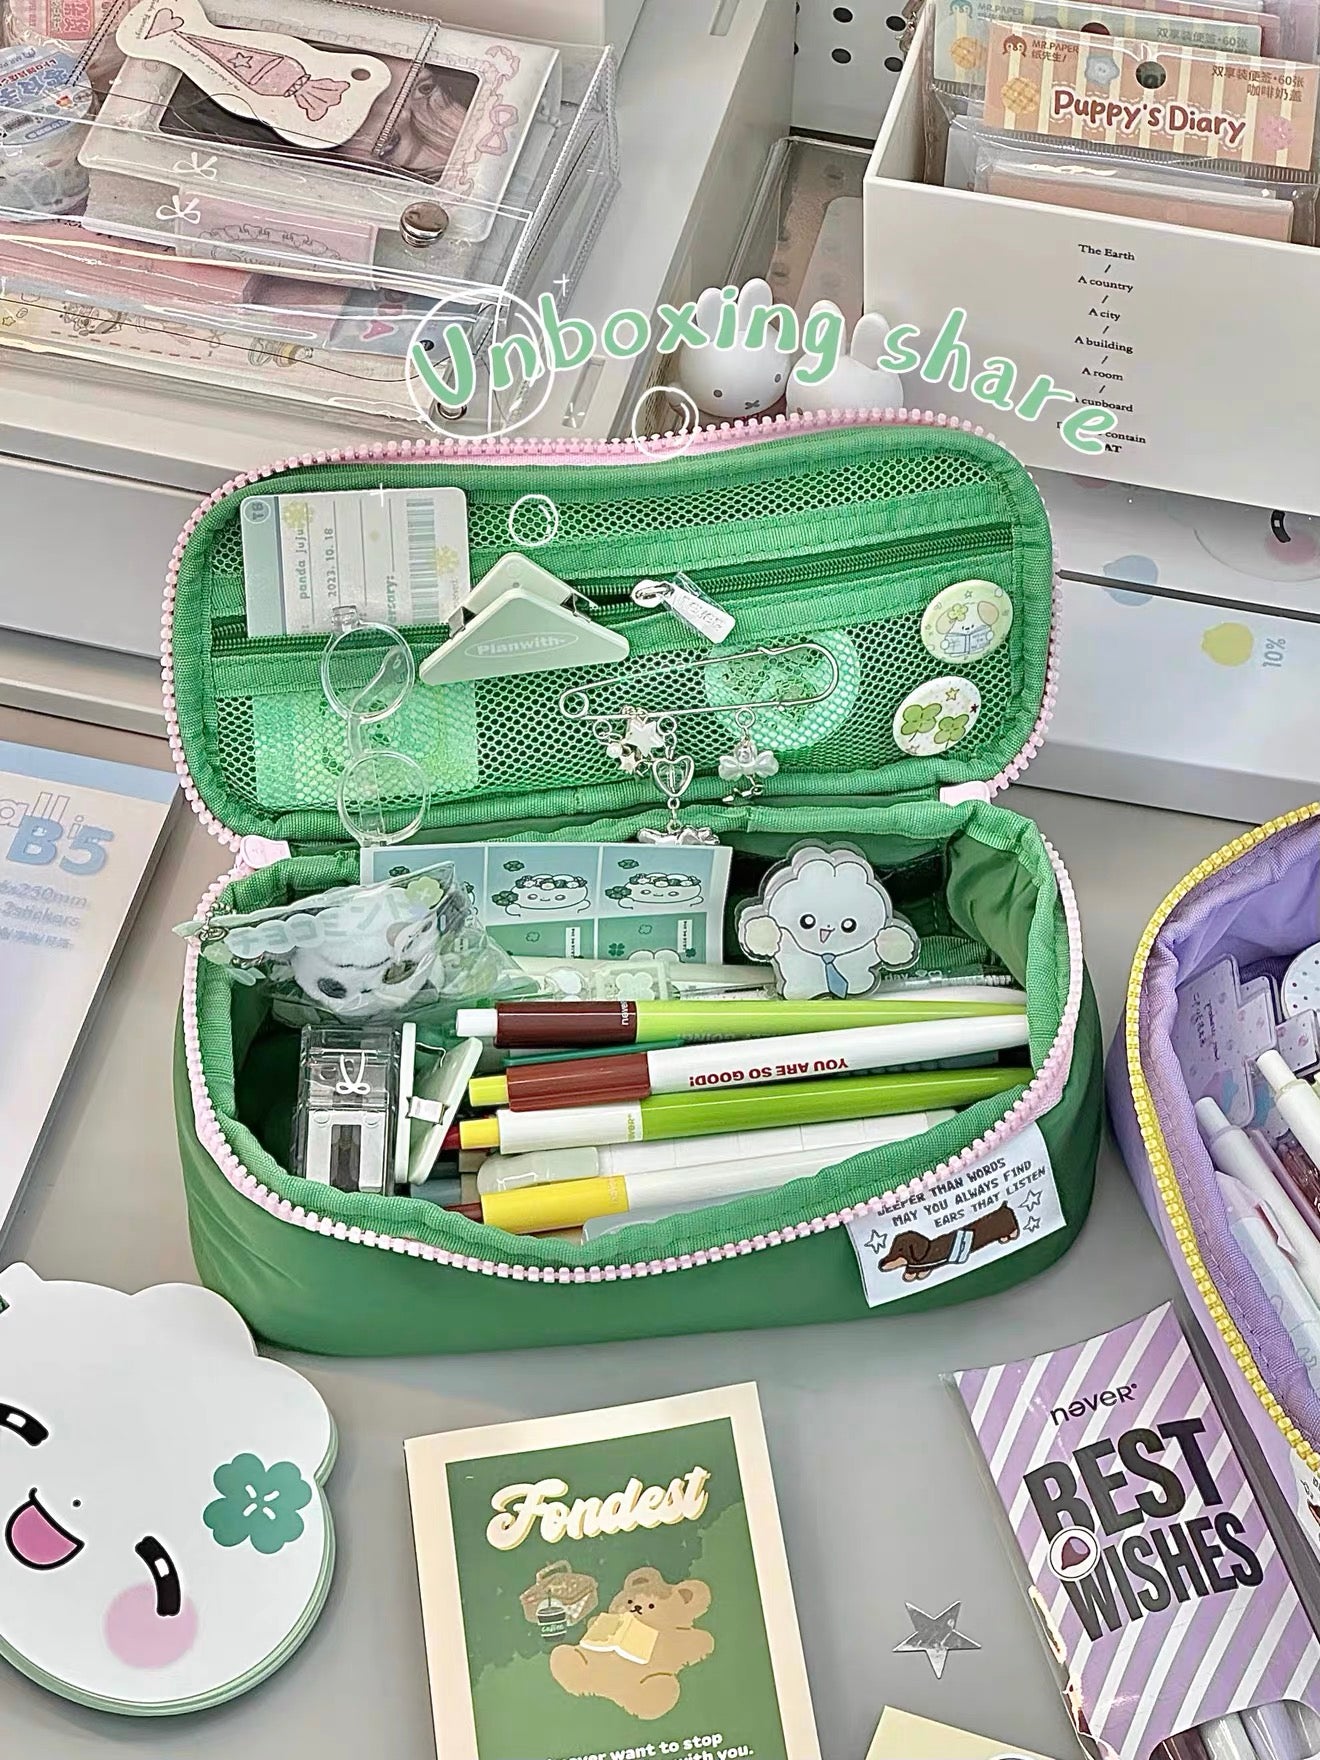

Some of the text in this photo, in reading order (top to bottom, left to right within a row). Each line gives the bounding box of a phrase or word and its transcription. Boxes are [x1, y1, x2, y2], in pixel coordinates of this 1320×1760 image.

[1054, 89, 1246, 144] Puppy's Diary
[1078, 244, 1135, 261] The Earth
[1078, 275, 1134, 293] A country
[1088, 307, 1121, 322] A city
[1074, 335, 1134, 355] A building
[1081, 367, 1124, 381] A room
[1104, 443, 1122, 454] AT
[1105, 430, 1147, 444] contain
[295, 560, 310, 600] panda
[386, 574, 399, 624] ersary:
[1262, 637, 1286, 669] 10%
[6, 814, 115, 876] B5
[689, 1057, 849, 1087] YOU ARE SO GOOD!
[892, 1160, 1032, 1227] MAY YOU ALWAYS FIND
[931, 1177, 964, 1198] THAN
[966, 1158, 1007, 1183] WORDS
[933, 1166, 1046, 1228] EARS THAT LISTEN
[1023, 1417, 1224, 1544] BEST
[486, 1465, 711, 1551] Fondest
[1061, 1511, 1264, 1642] WISHES
[609, 1743, 657, 1760] want
[659, 1741, 680, 1755] to
[683, 1733, 723, 1751] stop
[717, 1743, 754, 1760] you.
